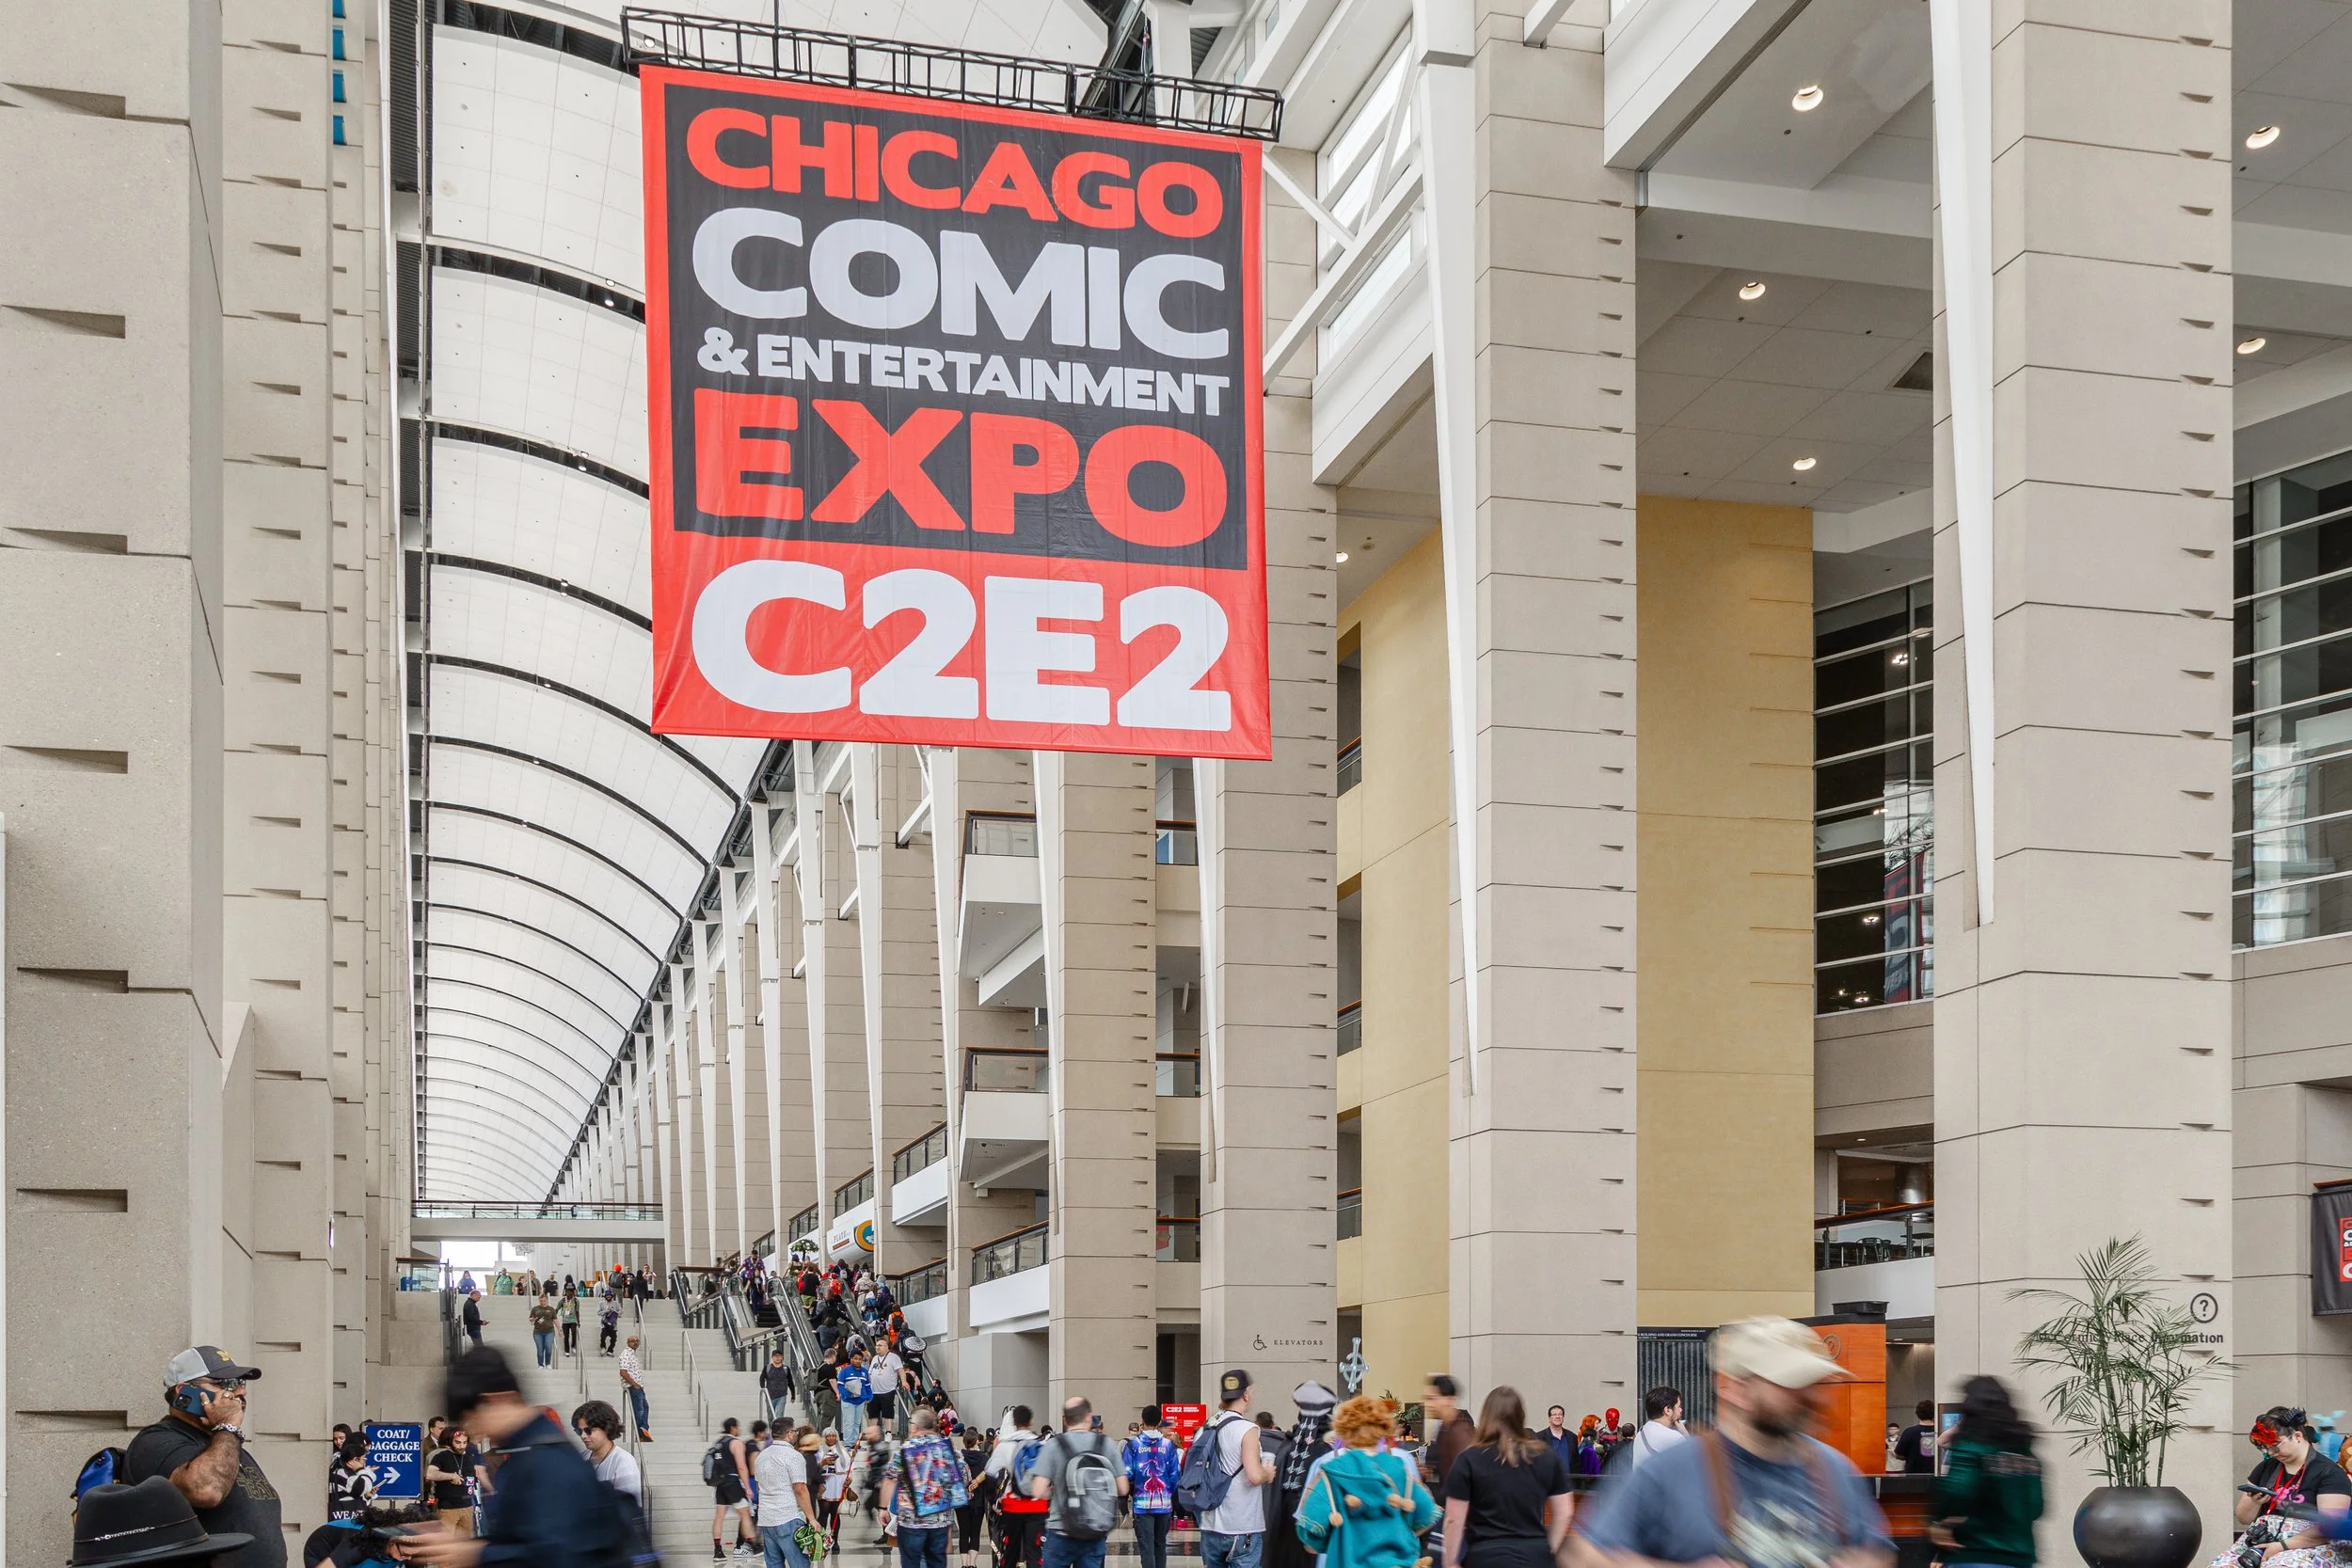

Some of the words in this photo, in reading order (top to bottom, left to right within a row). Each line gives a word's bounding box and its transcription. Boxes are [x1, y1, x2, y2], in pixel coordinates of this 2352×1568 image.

[686, 107, 1224, 238] CHICAGO
[691, 207, 1229, 359] COMIC
[696, 326, 752, 375] &
[757, 335, 1230, 417] ENTERTAINMENT
[693, 387, 1228, 547] EXPO
[692, 560, 1232, 731] C2E2
[368, 1441, 421, 1450] BAGGAGE
[373, 1452, 413, 1463] CHECK
[376, 1430, 410, 1439] COAT/
